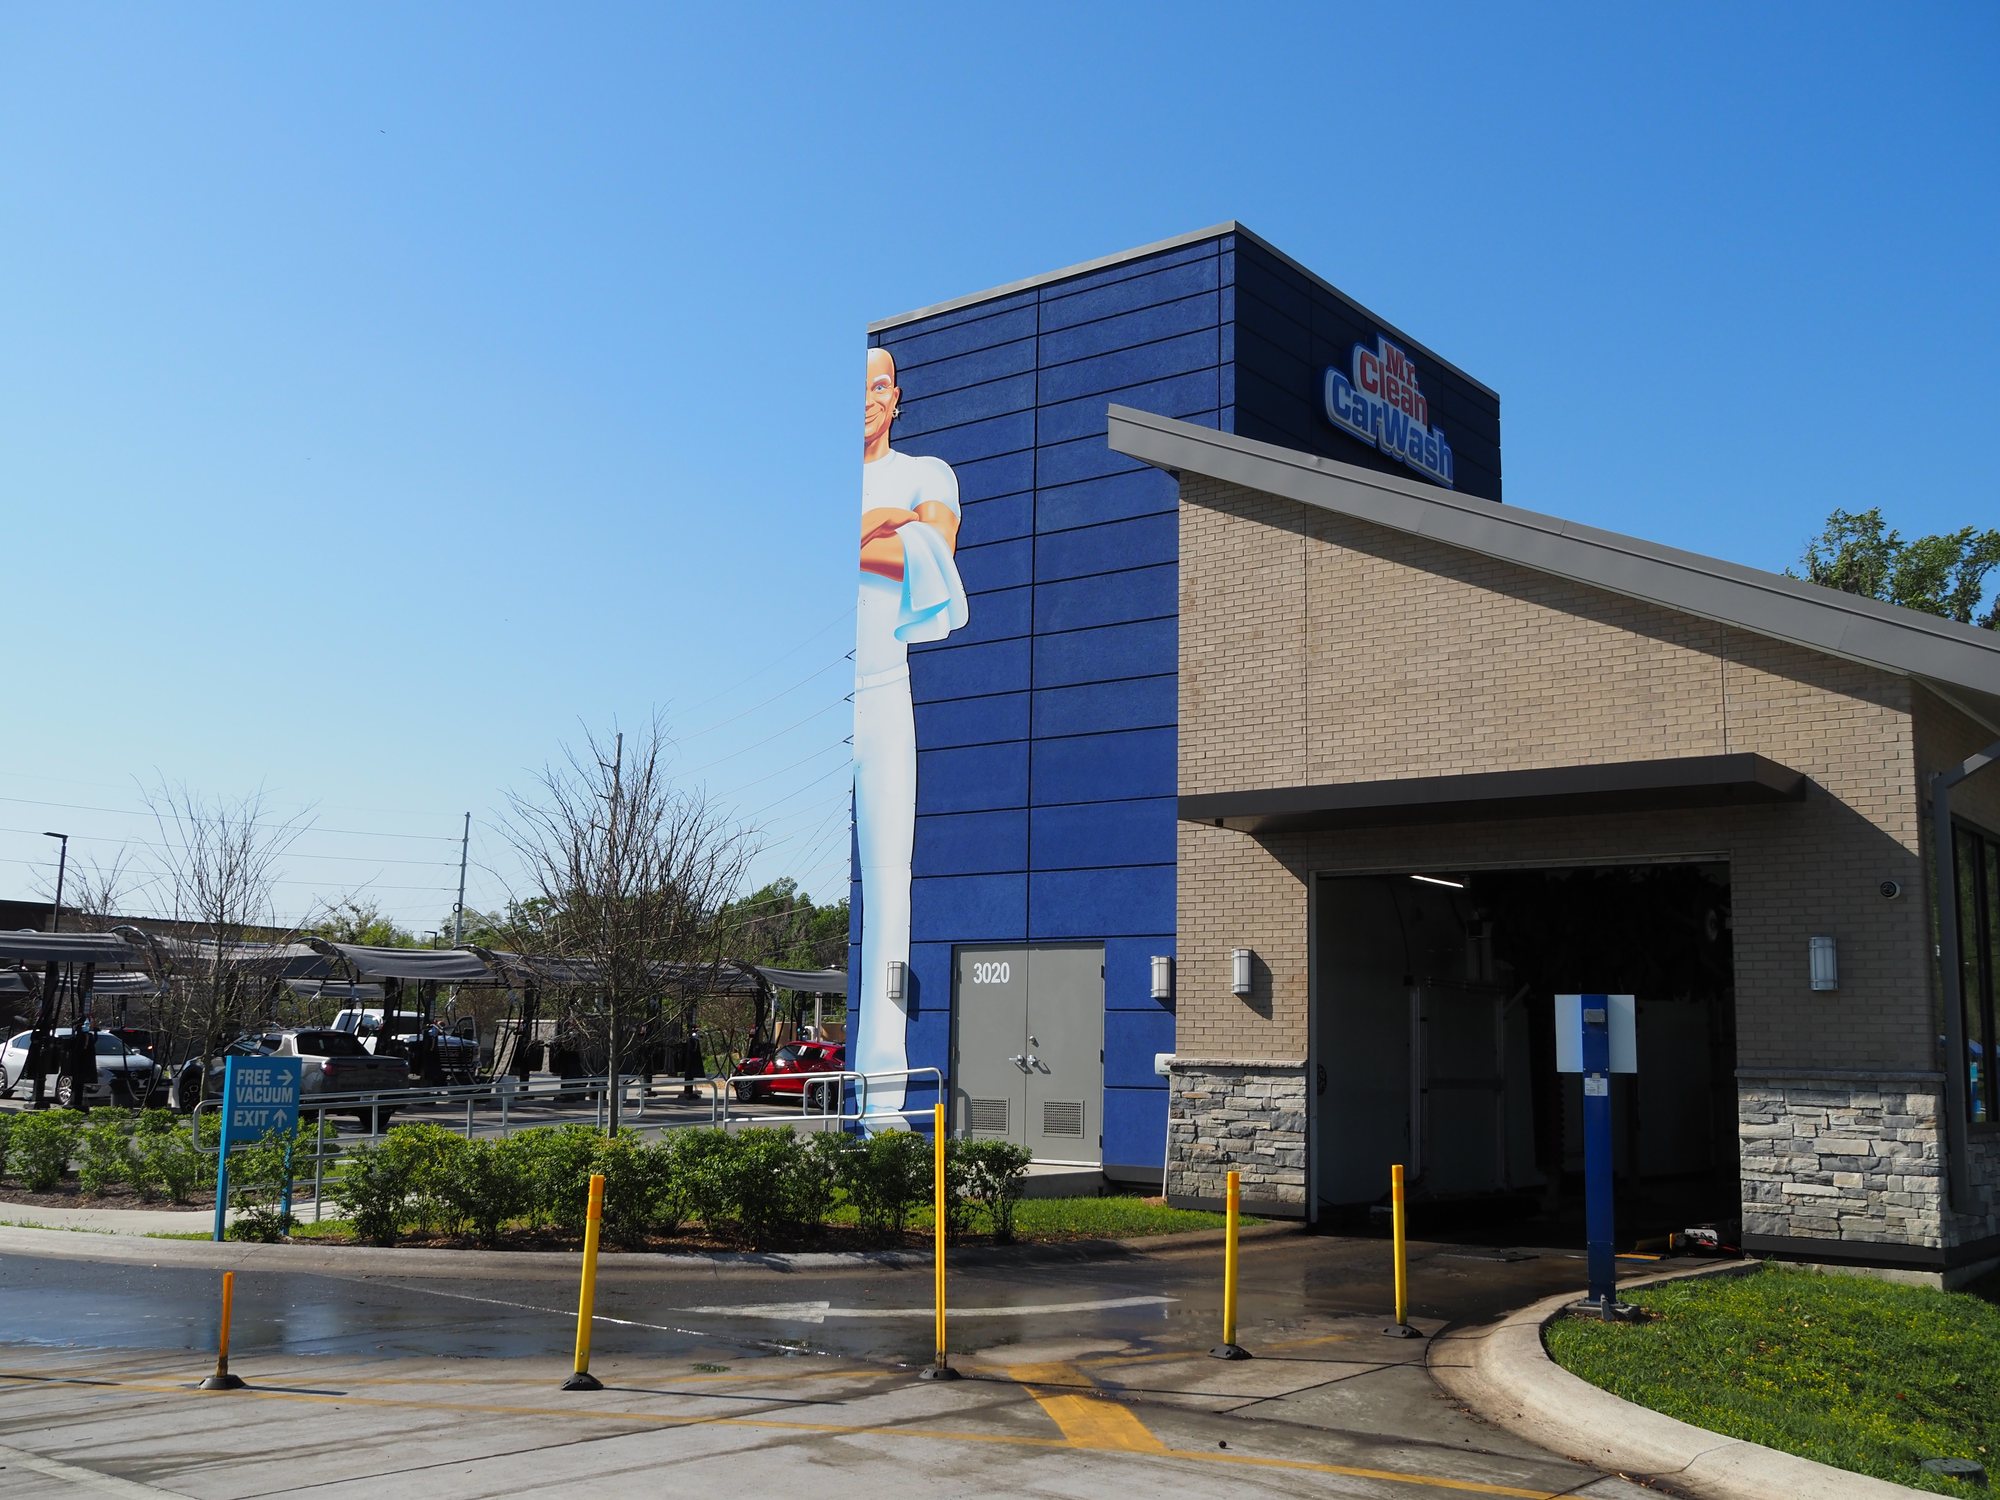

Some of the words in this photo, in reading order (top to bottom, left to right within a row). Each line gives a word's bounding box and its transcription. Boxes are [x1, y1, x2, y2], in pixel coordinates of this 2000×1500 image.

[1384, 343, 1419, 391] Mr.
[1360, 351, 1428, 426] Clean
[973, 962, 1010, 984] 3020
[236, 1069, 272, 1085] FREE
[236, 1087, 293, 1103] VACUUM
[233, 1110, 269, 1126] EXIT
